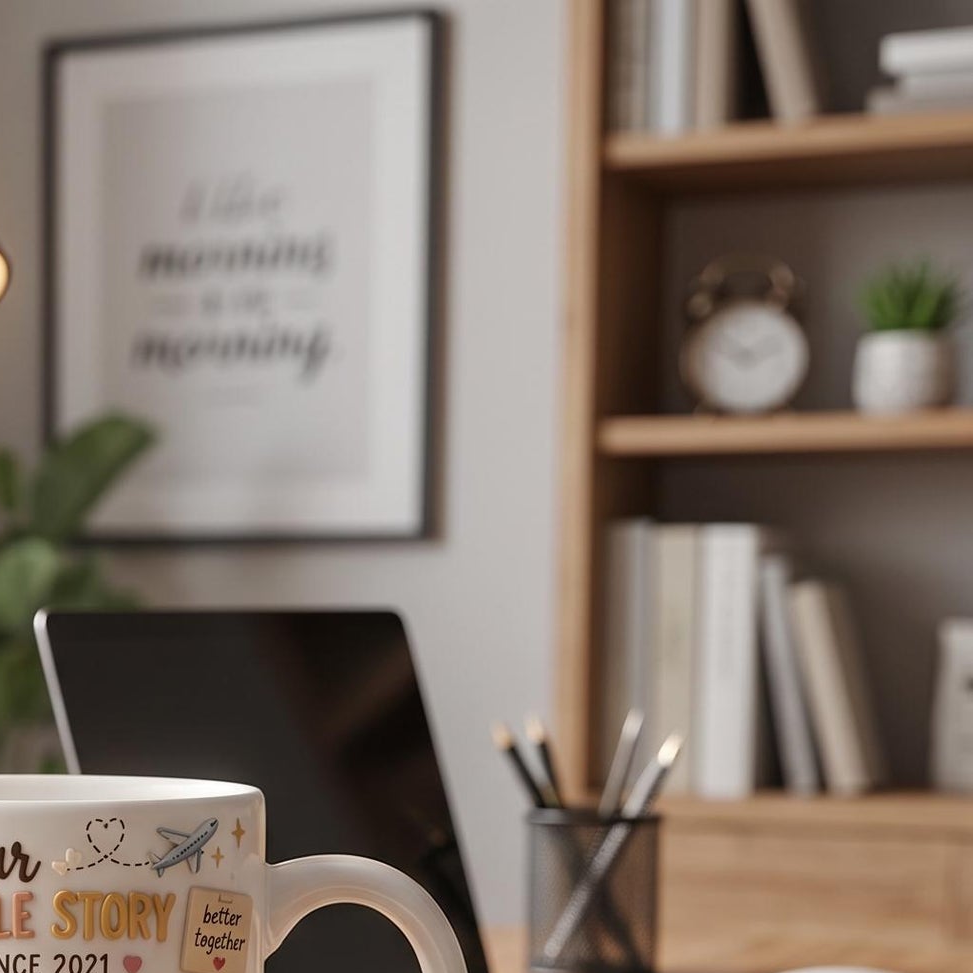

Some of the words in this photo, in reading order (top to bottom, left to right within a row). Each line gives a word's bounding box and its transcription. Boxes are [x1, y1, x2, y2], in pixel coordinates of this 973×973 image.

[51, 890, 176, 943] STORY
[203, 904, 242, 926] better
[194, 927, 246, 955] together
